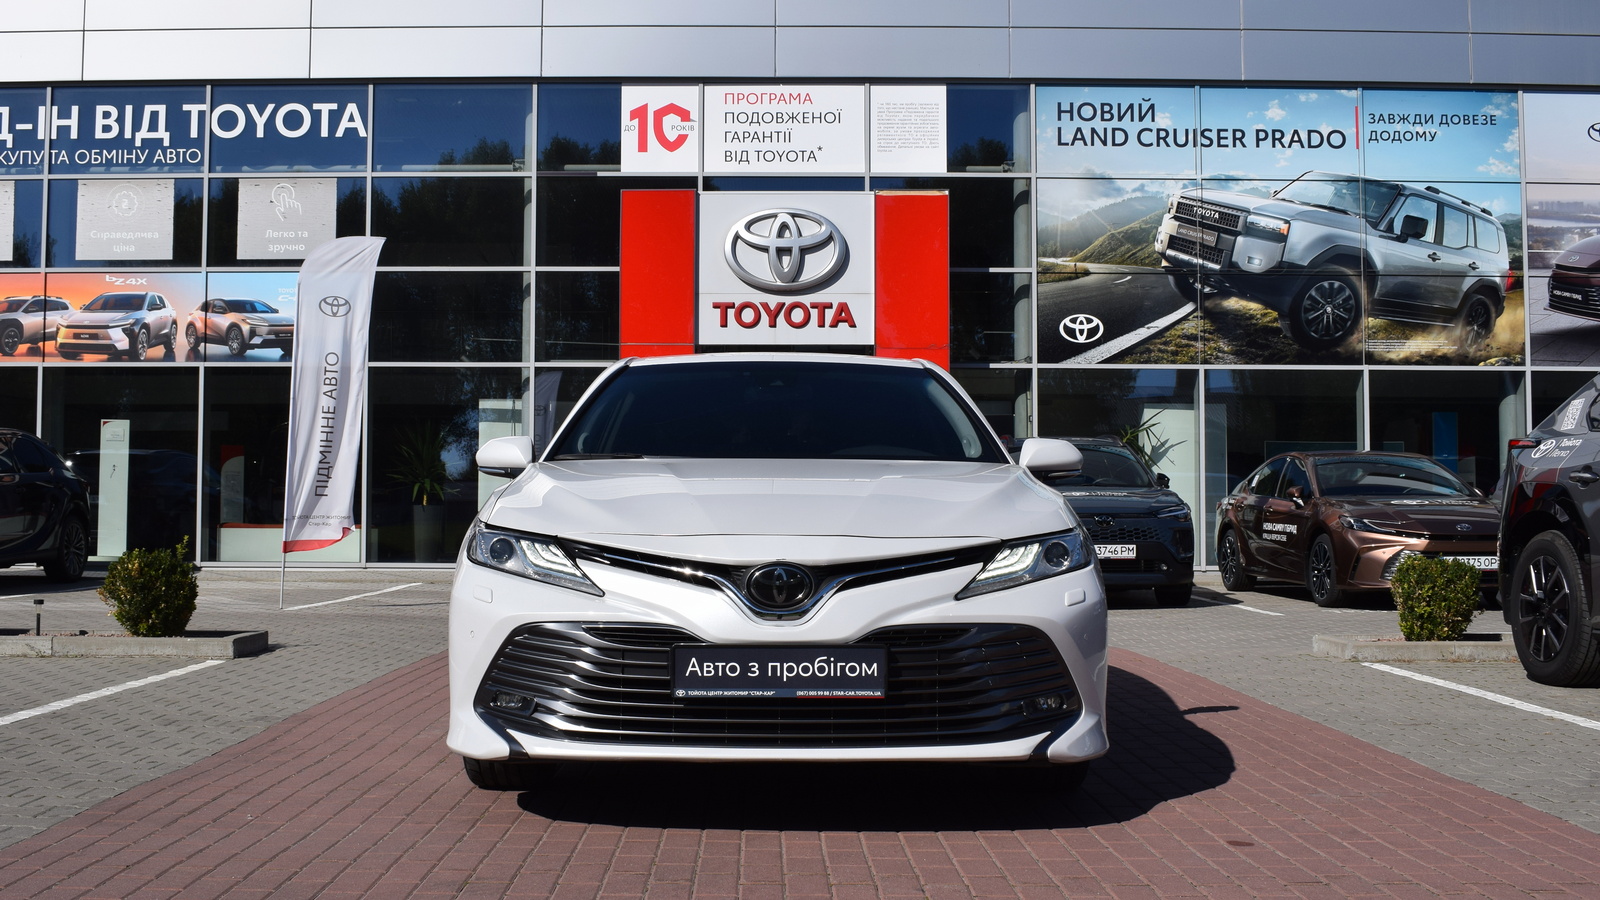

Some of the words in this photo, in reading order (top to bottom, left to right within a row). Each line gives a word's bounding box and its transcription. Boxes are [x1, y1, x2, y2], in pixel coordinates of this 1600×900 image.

[724, 92, 813, 105] ПРОГРАМА
[1057, 97, 1156, 122] НОВИЙ
[724, 108, 843, 126] ПОДОВЖЕНОЇ
[1368, 113, 1434, 127] ЗАВЖДИ
[1439, 114, 1497, 127] ДОВЕЗЕ
[95, 104, 170, 147] ВІД
[182, 103, 368, 139] TOYOTA
[724, 128, 793, 143] ГАРАНТІЇ
[1057, 127, 1129, 147] LAND
[1136, 127, 1247, 148] CRUISER
[1255, 128, 1347, 149] PRADO
[1368, 130, 1437, 144] ДОДОМУ
[50, 150, 70, 164] ТА
[75, 149, 149, 164] ОБМІНУ
[153, 148, 201, 164] АВТО
[724, 150, 750, 164] ВІД
[1193, 207, 1219, 219] TOYOTA
[90, 230, 159, 240] Справедлива
[265, 229, 295, 238] Легко
[113, 242, 135, 252] ціна
[268, 244, 305, 253] зручно
[712, 301, 857, 329] TOYOTA
[323, 352, 339, 400] АВТО
[315, 406, 336, 497] ПІДМІННЕ
[1097, 546, 1118, 555] 3746
[685, 657, 741, 677] Авто
[747, 661, 760, 677] з
[768, 656, 878, 682] пробігом
